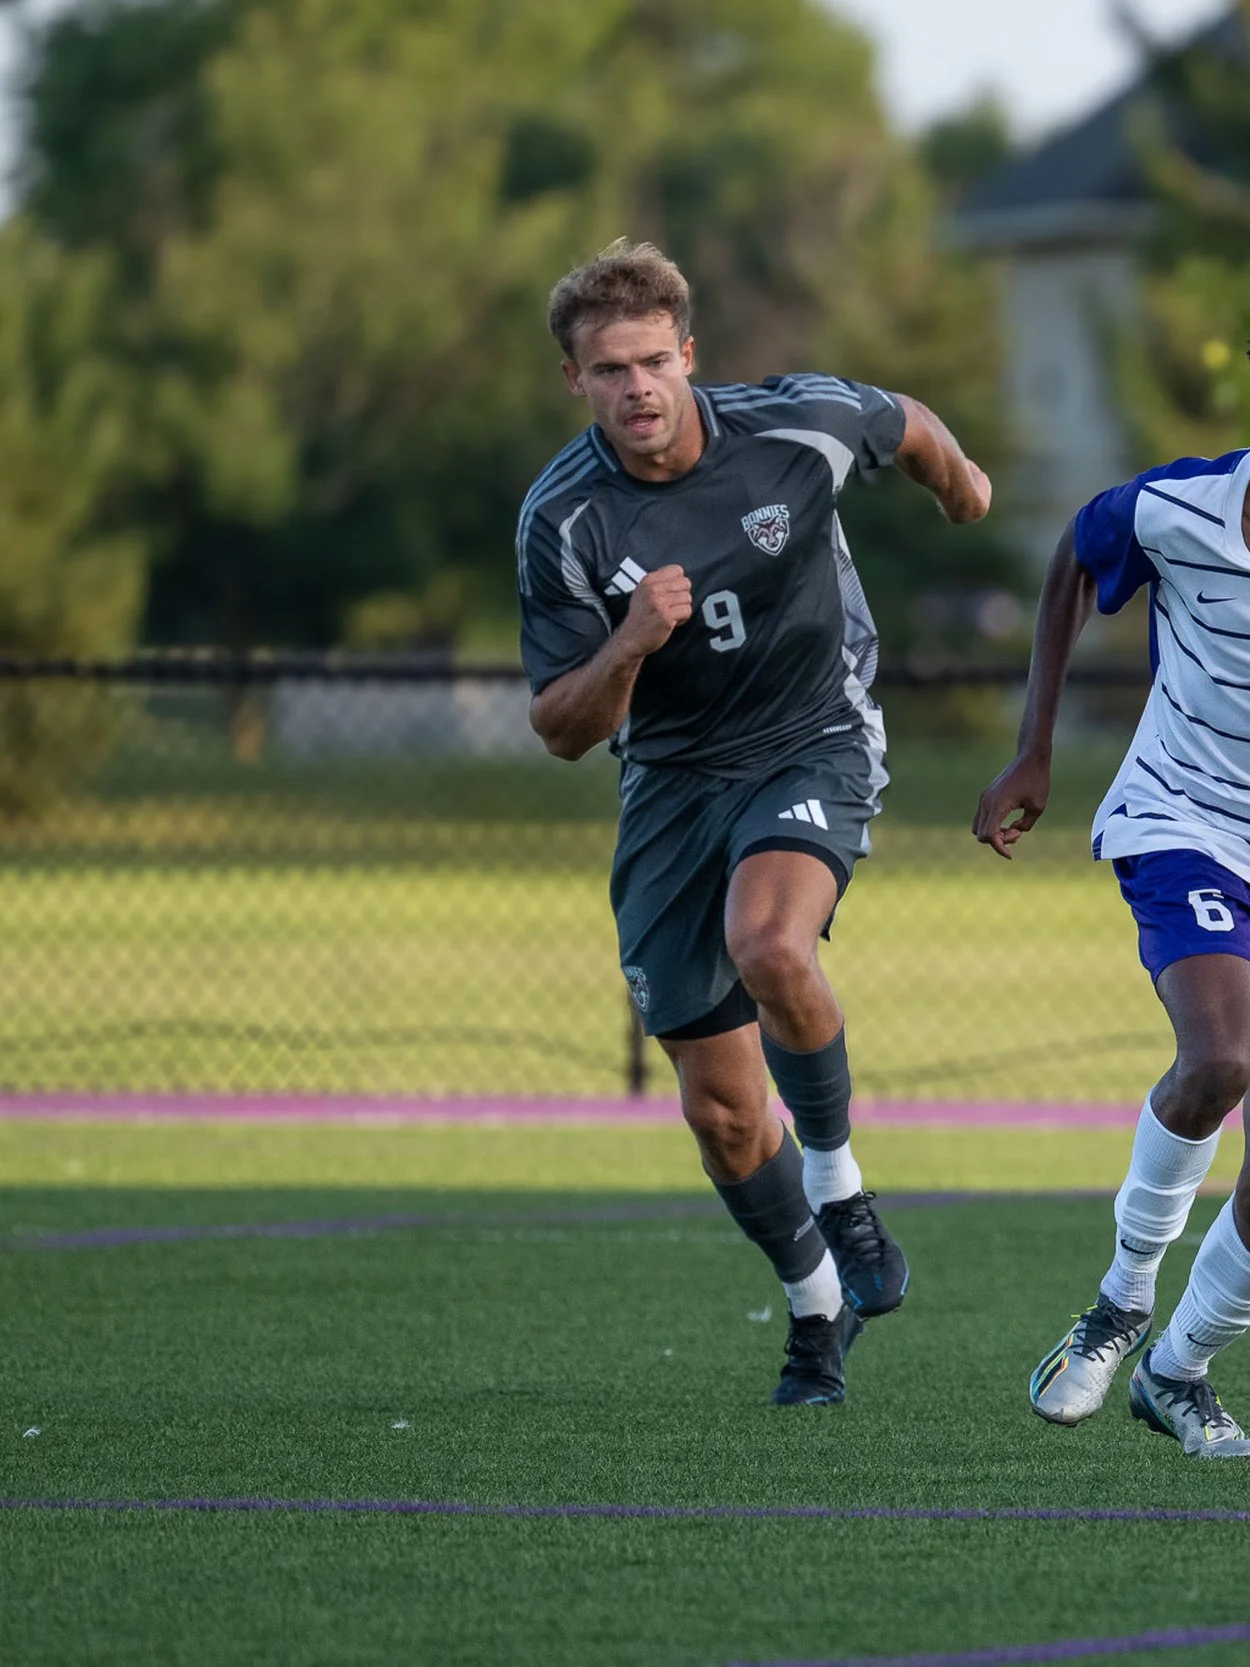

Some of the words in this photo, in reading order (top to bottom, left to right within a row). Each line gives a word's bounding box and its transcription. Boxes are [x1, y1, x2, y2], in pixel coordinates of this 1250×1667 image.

[741, 504, 790, 532] BONNIES
[702, 590, 746, 652] 9
[1188, 889, 1235, 931] 6
